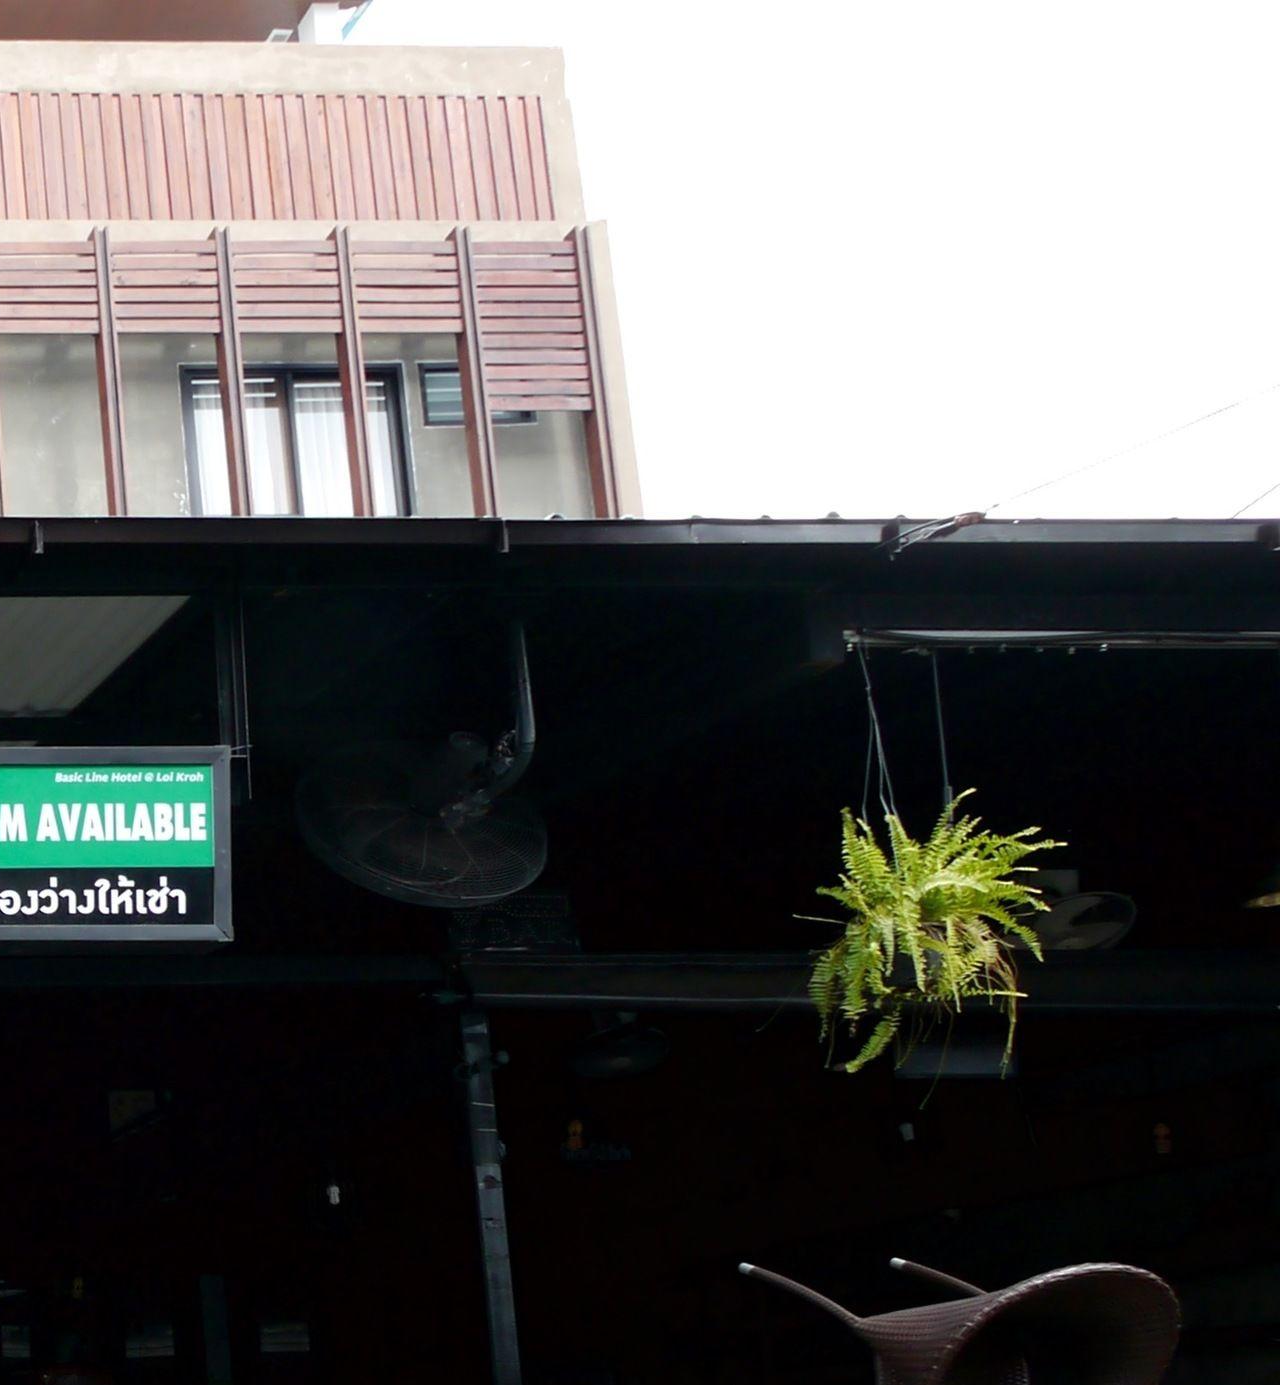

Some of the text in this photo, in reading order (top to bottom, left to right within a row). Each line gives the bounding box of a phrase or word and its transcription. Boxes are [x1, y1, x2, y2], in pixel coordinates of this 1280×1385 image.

[54, 772, 83, 783] Basic
[85, 772, 109, 783] Line
[111, 772, 142, 783] Hotel
[156, 772, 174, 783] Loi
[175, 771, 205, 783] Kroh
[36, 803, 207, 842] AVAILABLE
